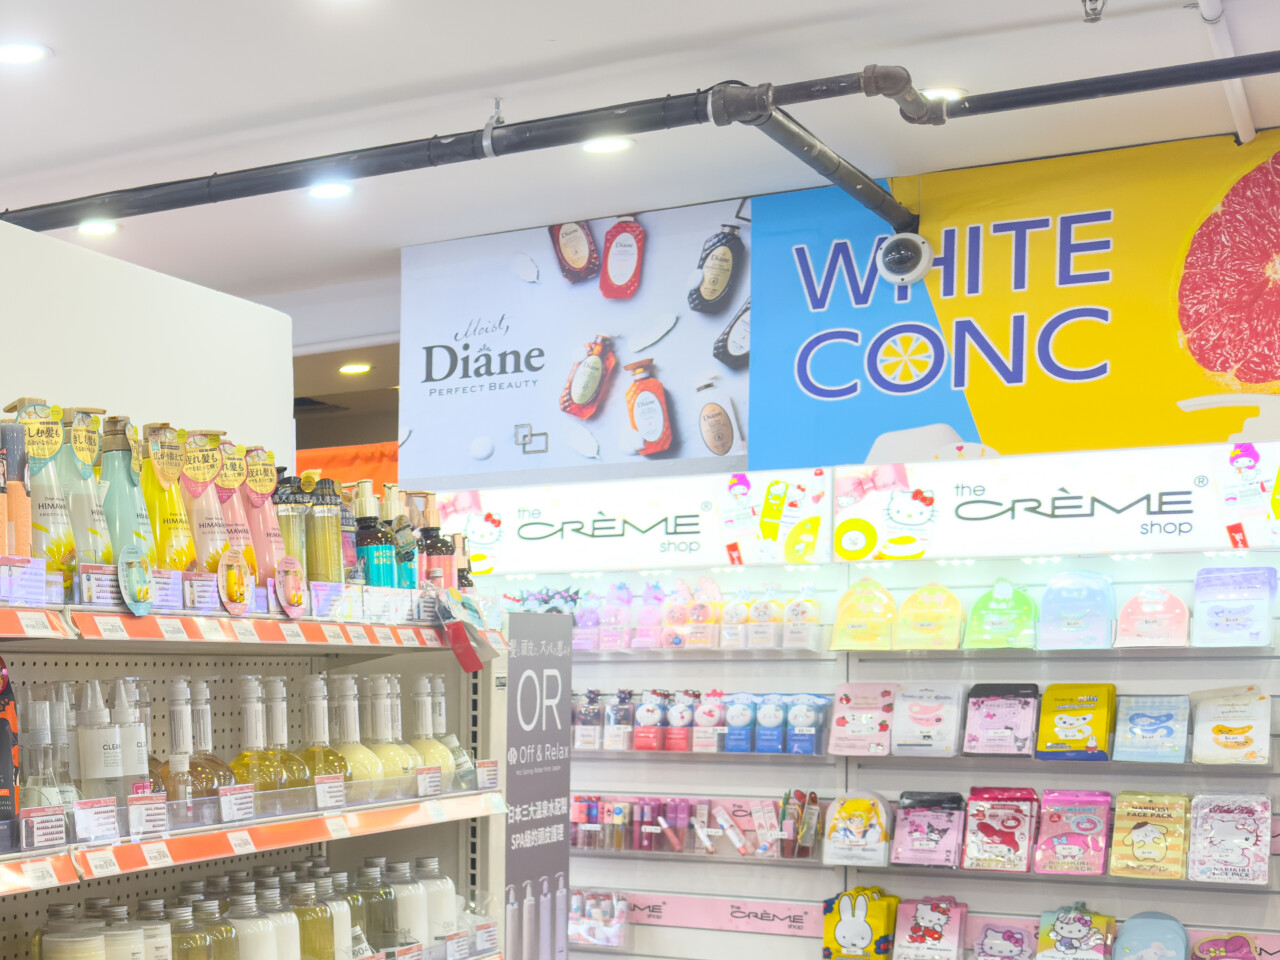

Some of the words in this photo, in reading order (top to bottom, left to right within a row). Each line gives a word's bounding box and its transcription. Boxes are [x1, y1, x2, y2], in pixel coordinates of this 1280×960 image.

[793, 209, 1113, 312] WHITE
[795, 306, 1112, 399] CONC
[429, 383, 485, 397] PERFECT
[488, 378, 539, 392] BEAUTY
[954, 482, 986, 498] the
[517, 505, 542, 520] the
[954, 487, 1193, 521] CRÈME
[517, 510, 701, 541] CRÈME
[1140, 520, 1193, 536] shop
[659, 539, 701, 554] shop
[516, 668, 562, 732] OR
[519, 745, 536, 764] Off
[536, 746, 543, 762] &
[544, 743, 569, 760] Relax
